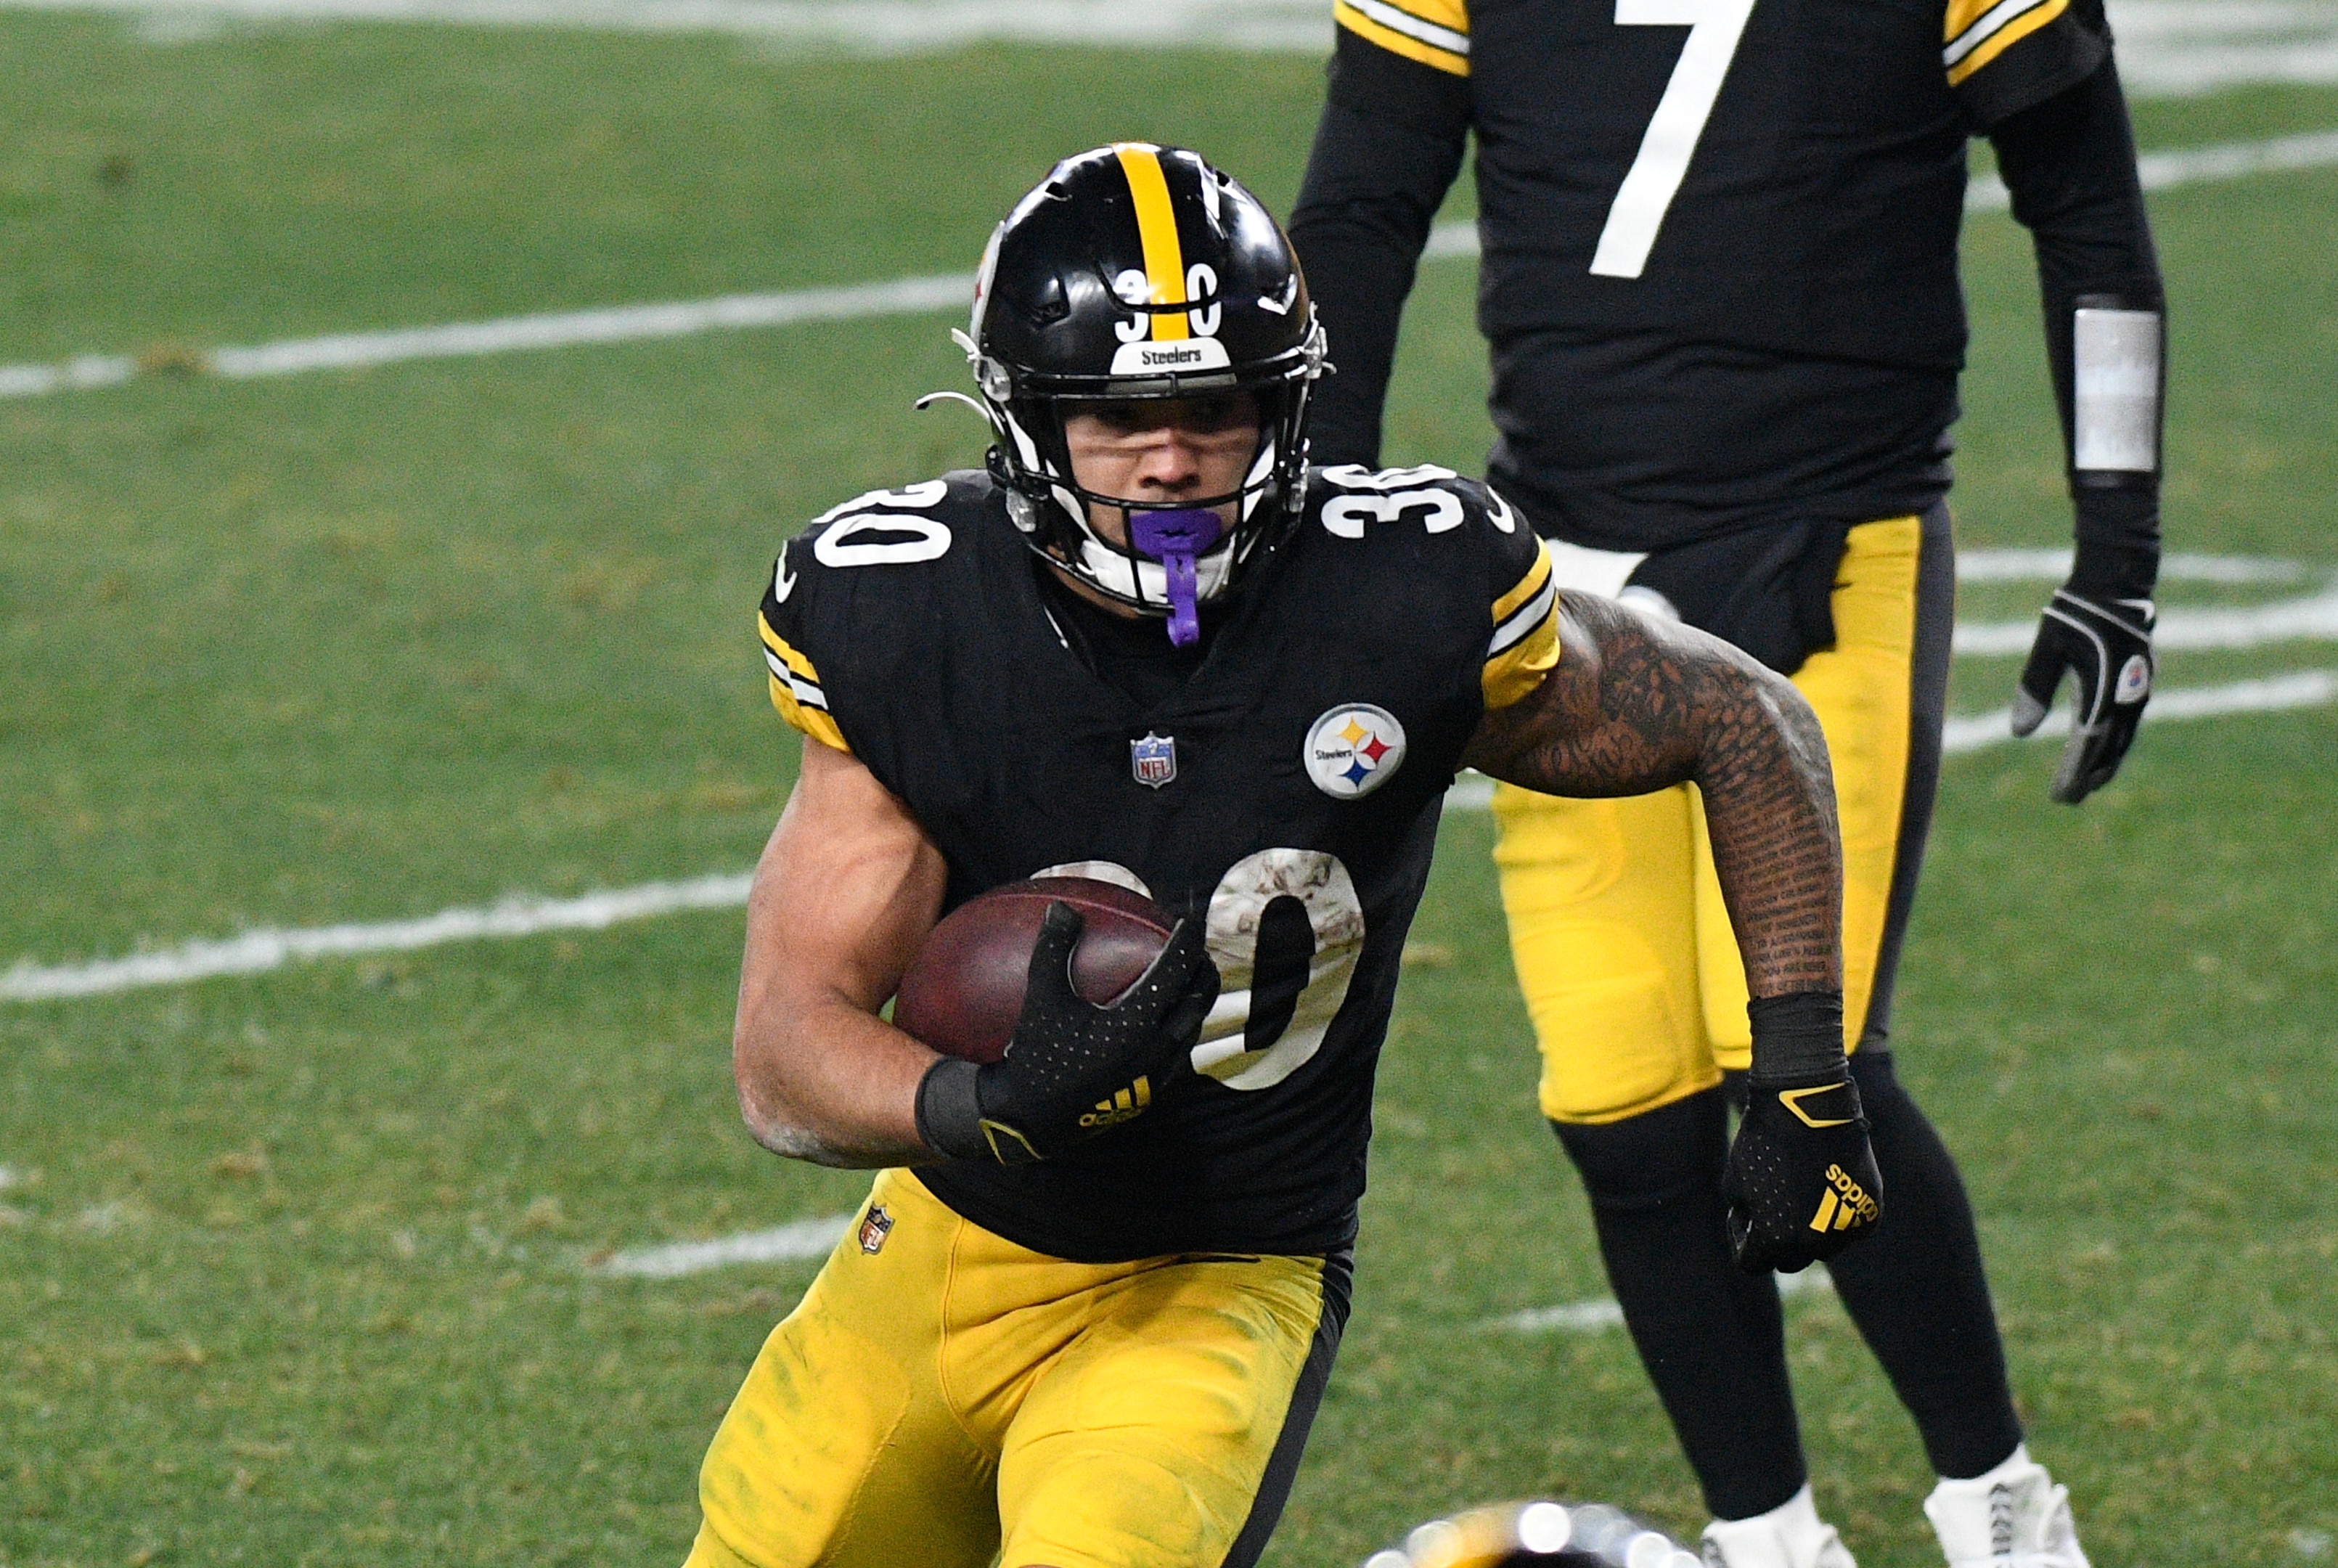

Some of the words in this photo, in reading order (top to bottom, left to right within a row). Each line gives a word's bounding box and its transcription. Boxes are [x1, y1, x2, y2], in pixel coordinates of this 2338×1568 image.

[1587, 0, 1753, 279] 7
[1142, 346, 1202, 365] Steelers
[1315, 748, 1352, 761] Steelers
[1140, 759, 1173, 780] NFL
[1825, 1163, 1879, 1222] adidas
